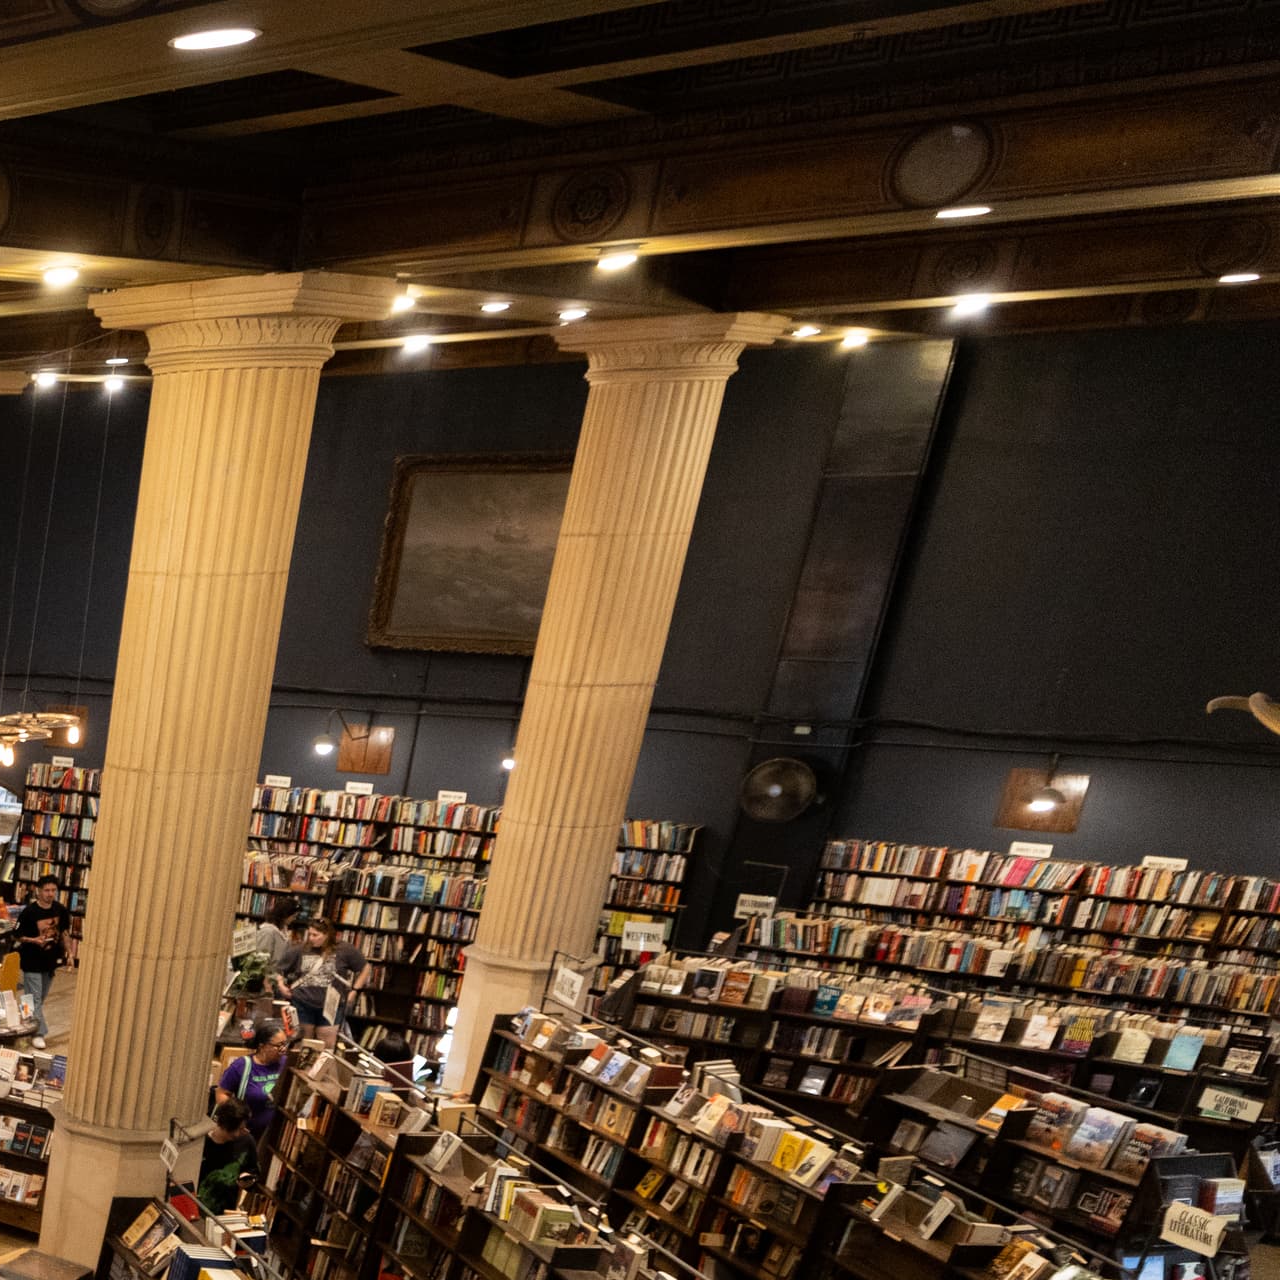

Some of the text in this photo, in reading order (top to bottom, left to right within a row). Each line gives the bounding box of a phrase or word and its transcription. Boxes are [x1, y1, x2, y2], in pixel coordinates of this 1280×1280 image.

[625, 932, 660, 942] WESTERNS
[1214, 1104, 1240, 1116] HISTORY
[1215, 1095, 1248, 1110] CALIFORNIA
[1179, 1210, 1210, 1230] CLASSIC
[1169, 1220, 1213, 1246] LITERATURE
